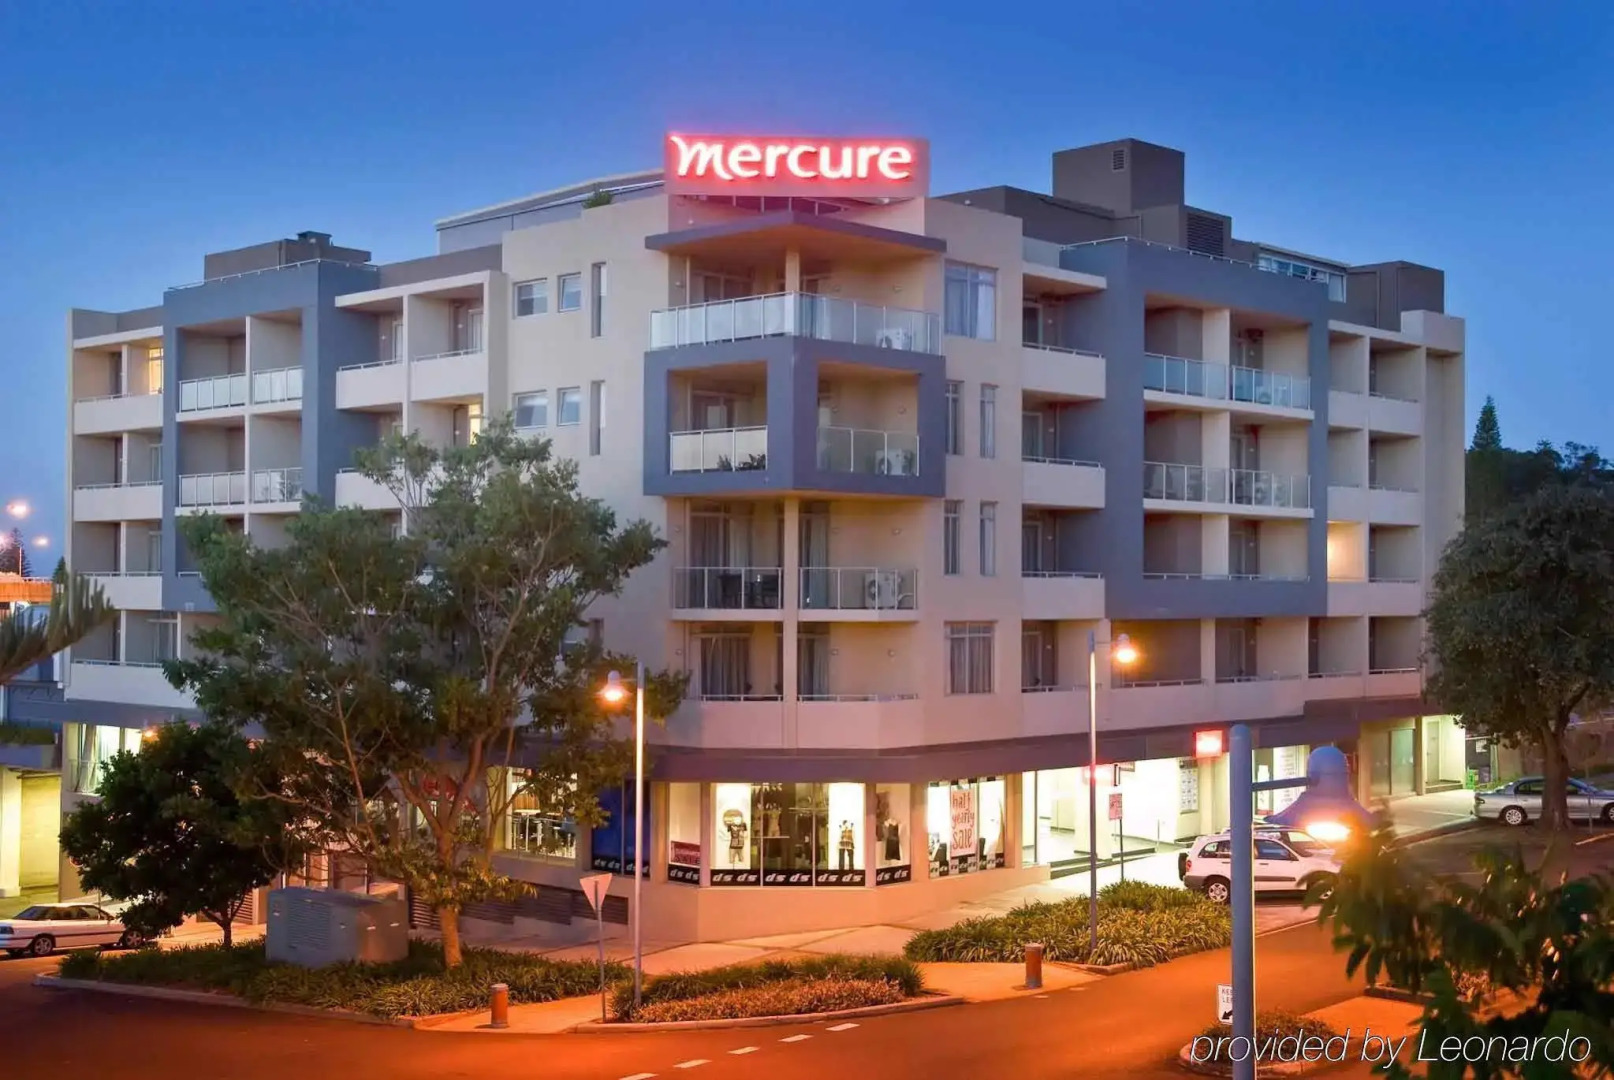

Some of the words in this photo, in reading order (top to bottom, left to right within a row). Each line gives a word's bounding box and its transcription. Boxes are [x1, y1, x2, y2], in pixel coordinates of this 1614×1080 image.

[670, 135, 912, 180] mercure
[953, 792, 970, 811] half
[952, 811, 975, 829] yearly
[952, 829, 973, 850] sale
[712, 873, 733, 882] ds
[737, 873, 758, 882] ds
[765, 873, 786, 882] ds
[789, 873, 811, 882] ds
[817, 873, 838, 882] ds
[842, 873, 863, 882] ds
[876, 871, 891, 881] ds
[894, 869, 908, 879] ds
